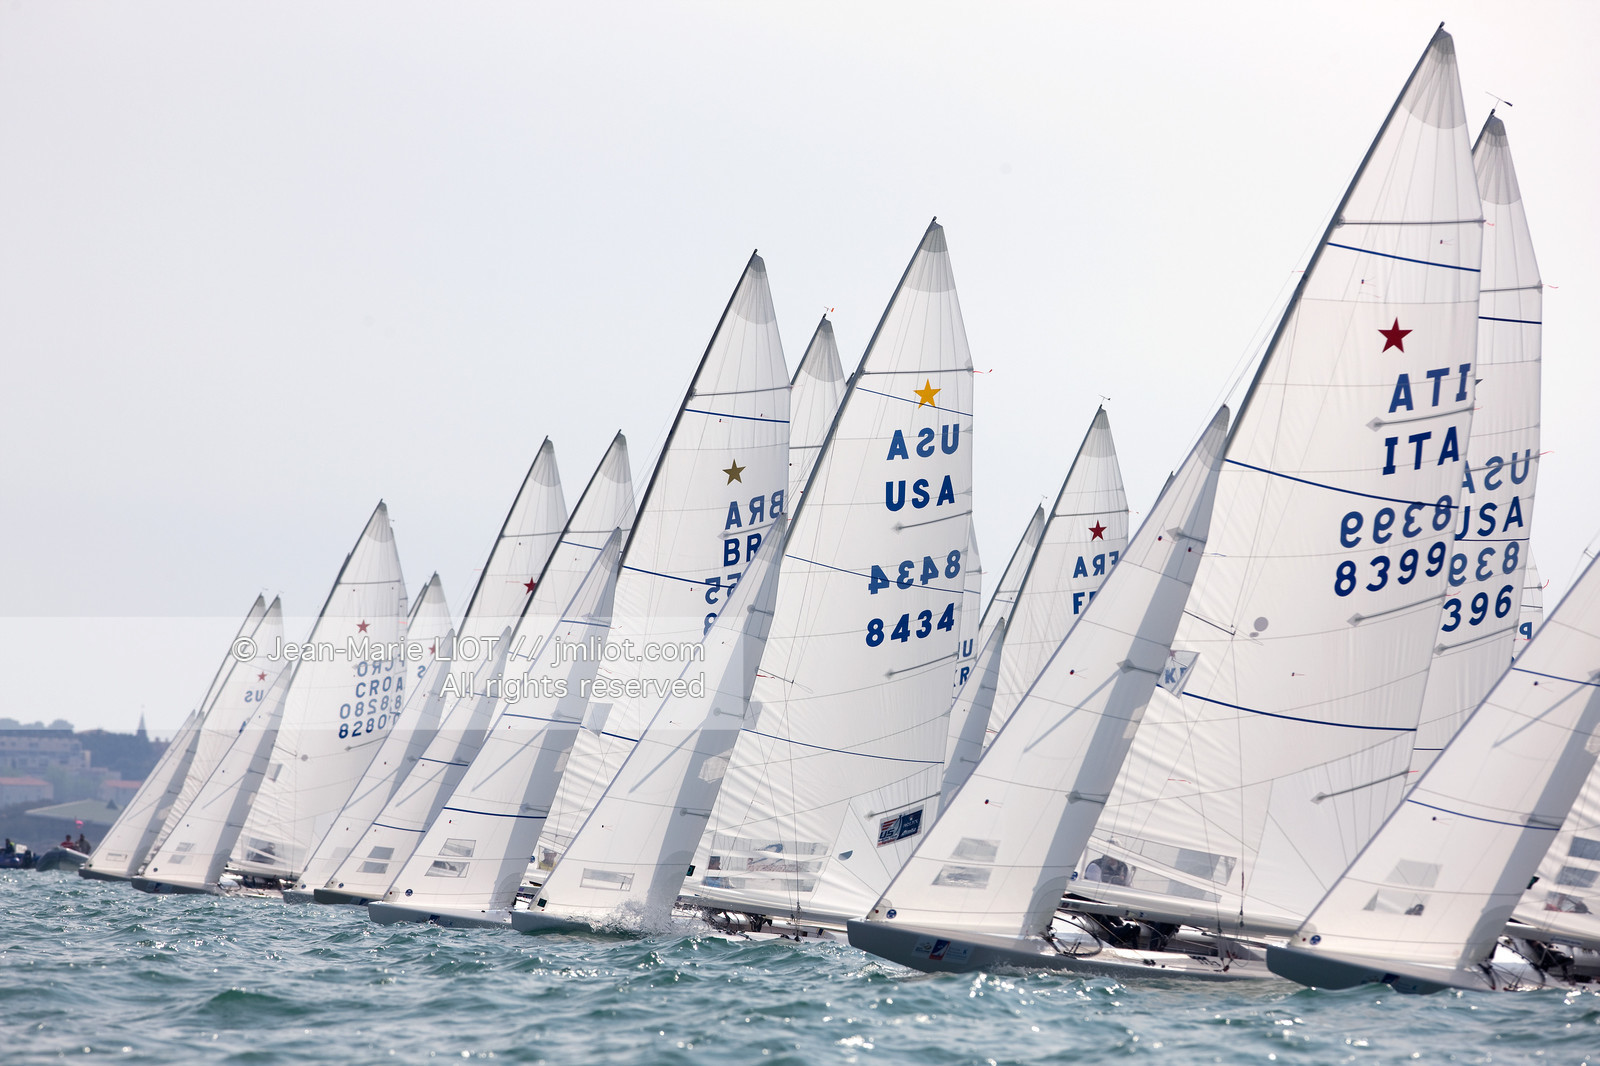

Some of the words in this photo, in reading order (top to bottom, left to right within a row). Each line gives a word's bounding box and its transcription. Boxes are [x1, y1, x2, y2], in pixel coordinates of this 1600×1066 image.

[1382, 426, 1460, 475] ITA
[885, 474, 955, 512] USA
[1334, 541, 1447, 597] 8399
[865, 602, 955, 647] 8434
[1441, 584, 1514, 632] 396
[338, 714, 387, 739] 8280
